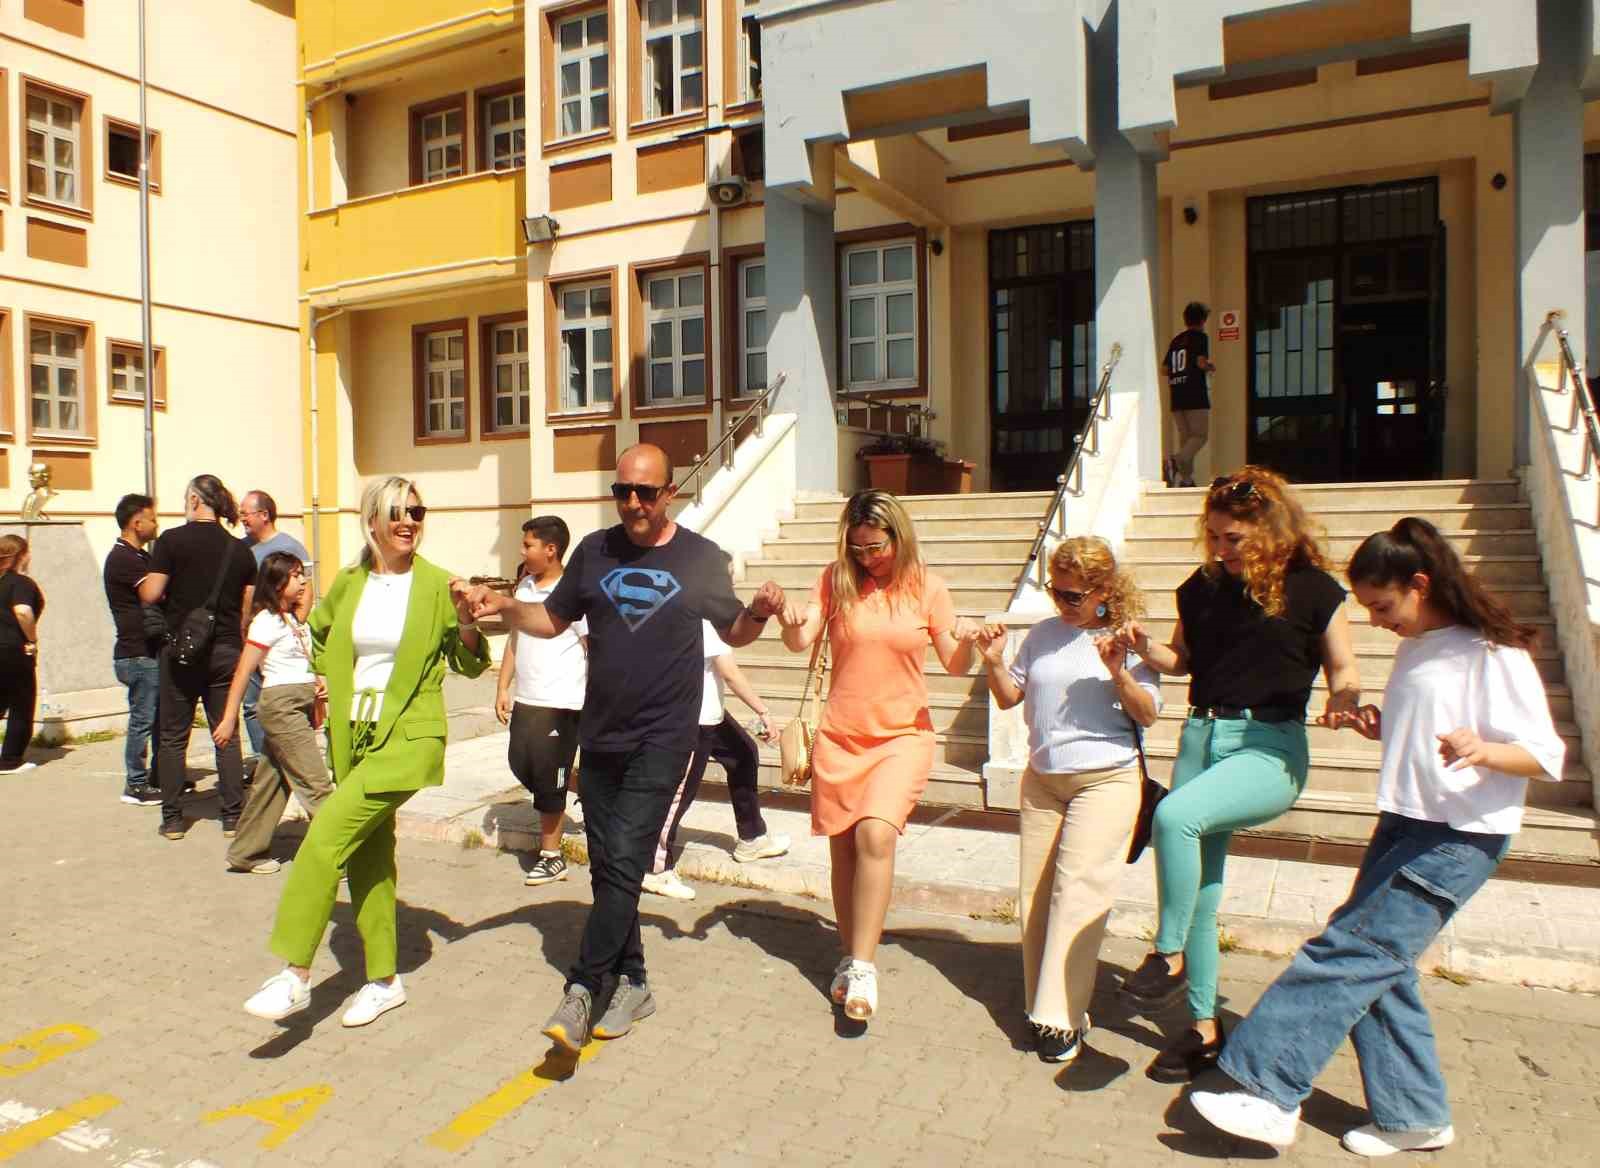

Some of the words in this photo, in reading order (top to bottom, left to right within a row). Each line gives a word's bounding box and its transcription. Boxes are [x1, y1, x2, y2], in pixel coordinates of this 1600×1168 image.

[1172, 349, 1187, 373] 10
[605, 568, 669, 616] S
[202, 1084, 334, 1151] A
